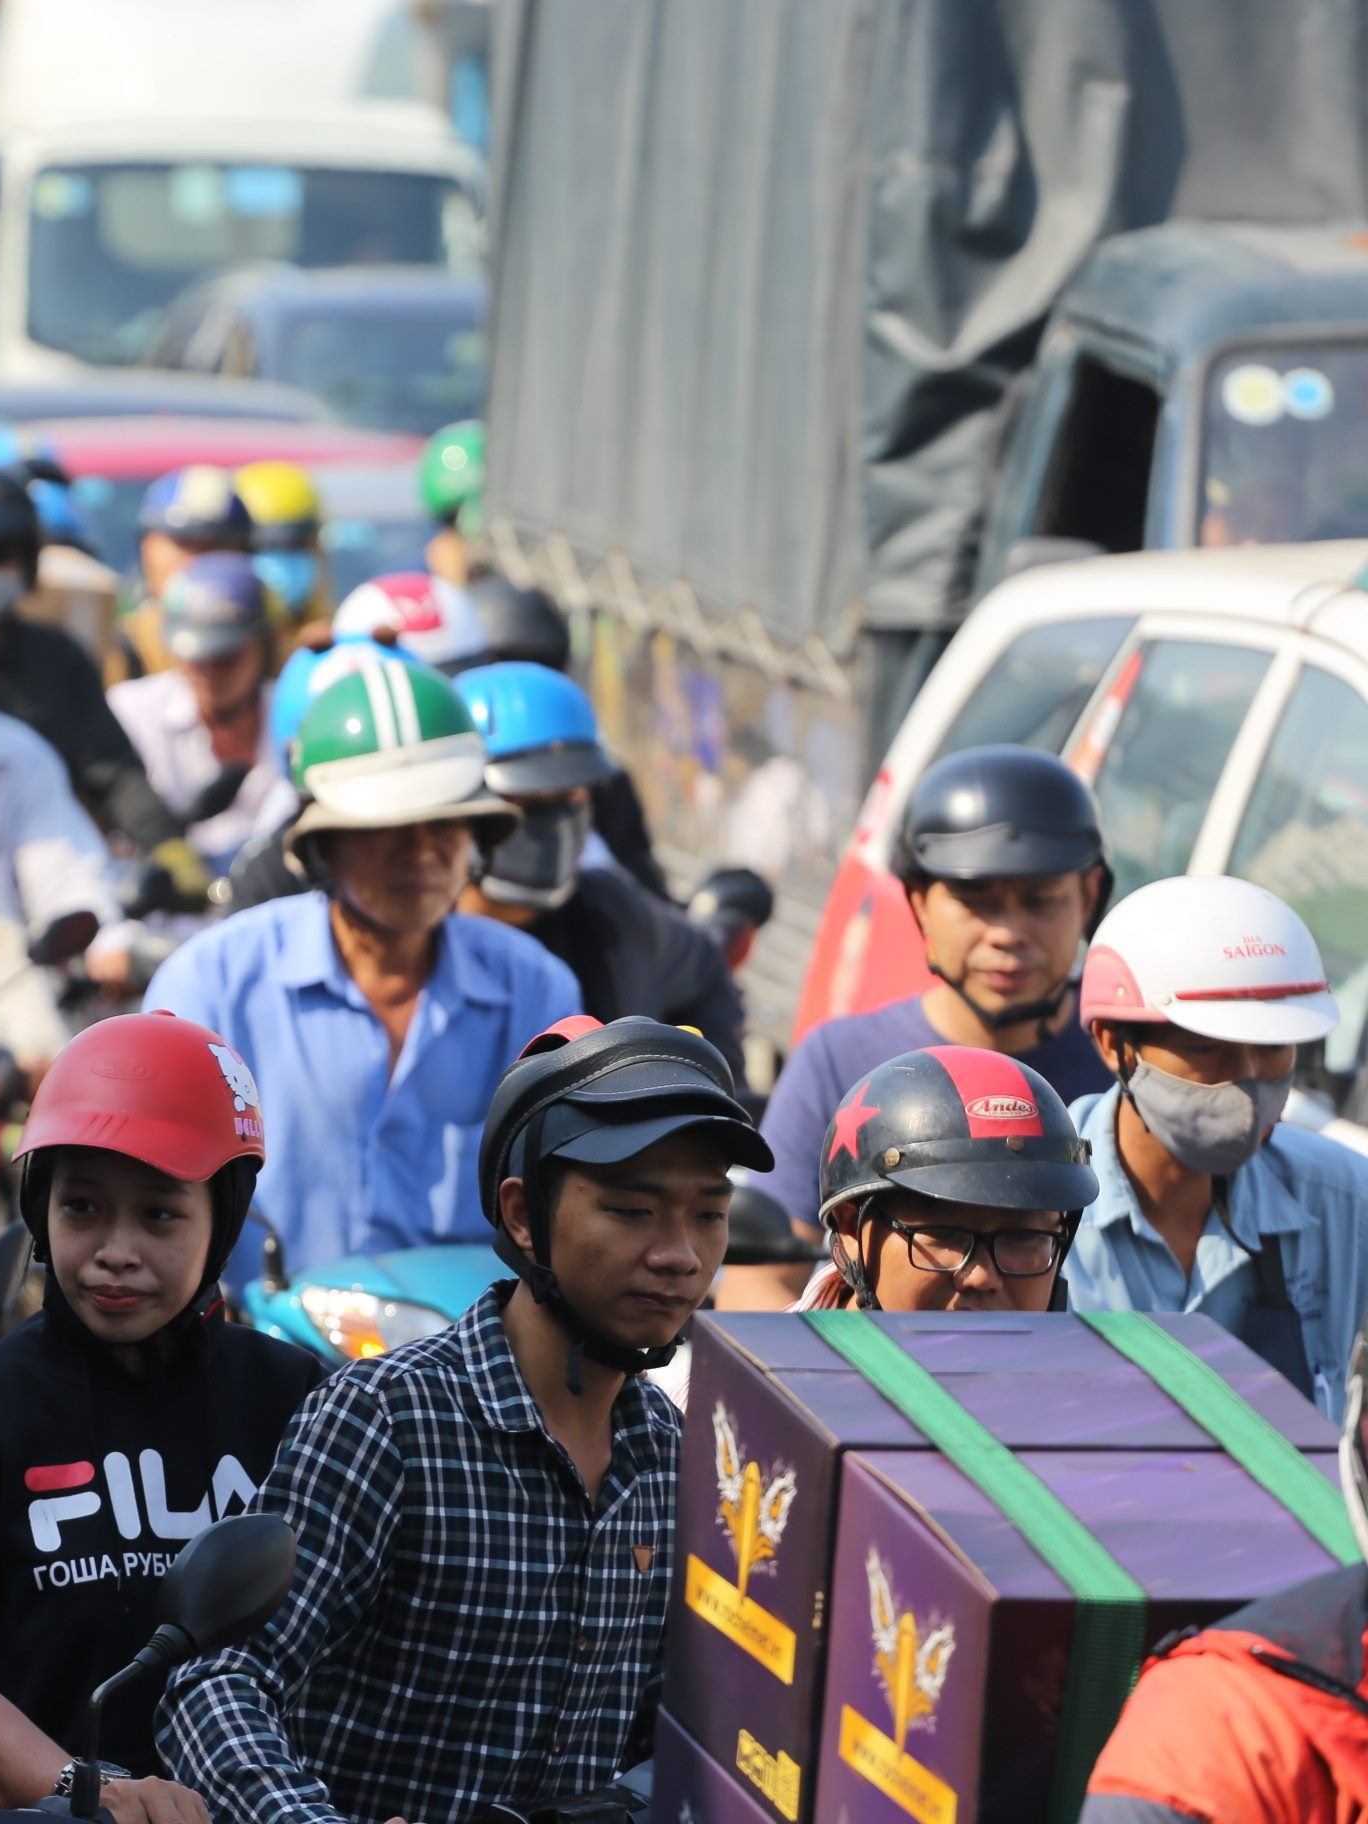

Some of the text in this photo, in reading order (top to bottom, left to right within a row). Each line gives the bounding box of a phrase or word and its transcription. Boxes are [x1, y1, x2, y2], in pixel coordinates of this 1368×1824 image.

[1223, 943, 1288, 960] SAIGON
[234, 1117, 264, 1139] HELL
[32, 1554, 120, 1592] ГОША
